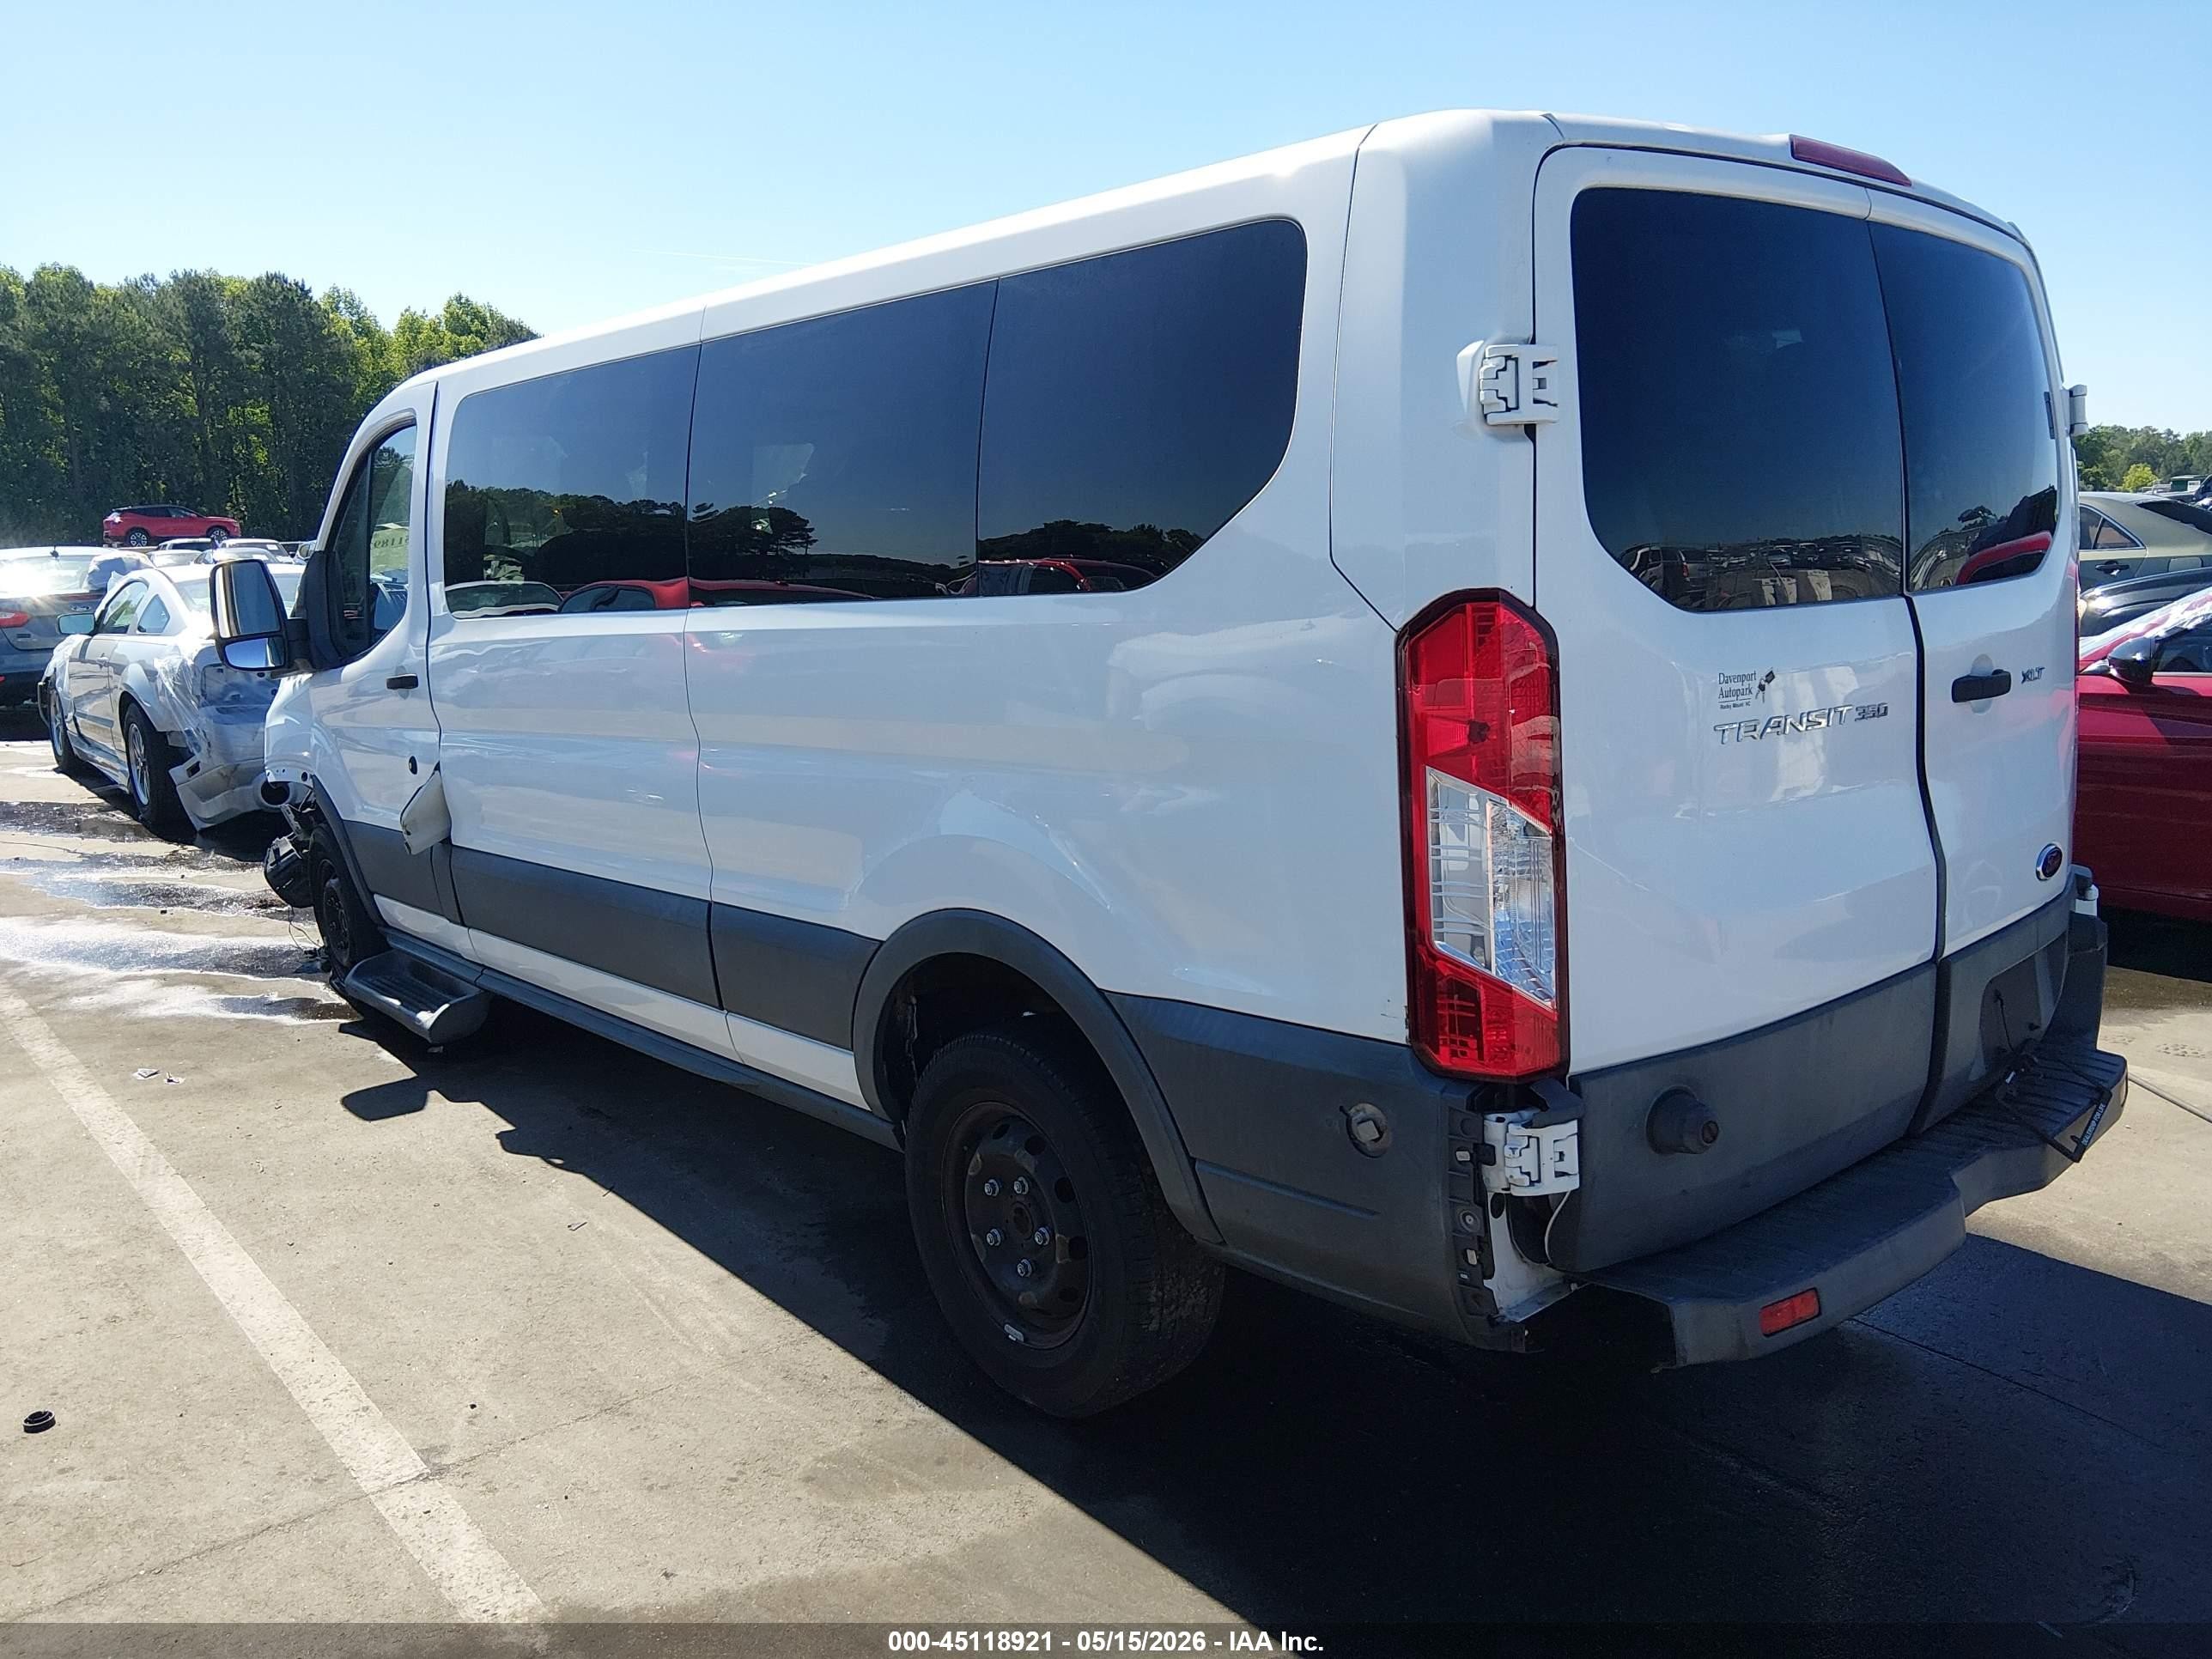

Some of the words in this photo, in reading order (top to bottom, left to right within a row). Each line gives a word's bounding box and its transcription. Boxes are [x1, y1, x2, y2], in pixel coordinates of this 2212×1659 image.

[1718, 670, 1757, 686] Davenport
[2021, 666, 2045, 684] XLT
[1718, 684, 1753, 701] Autopark
[1714, 704, 1853, 744] TRANSIT
[1854, 702, 1888, 722] 350
